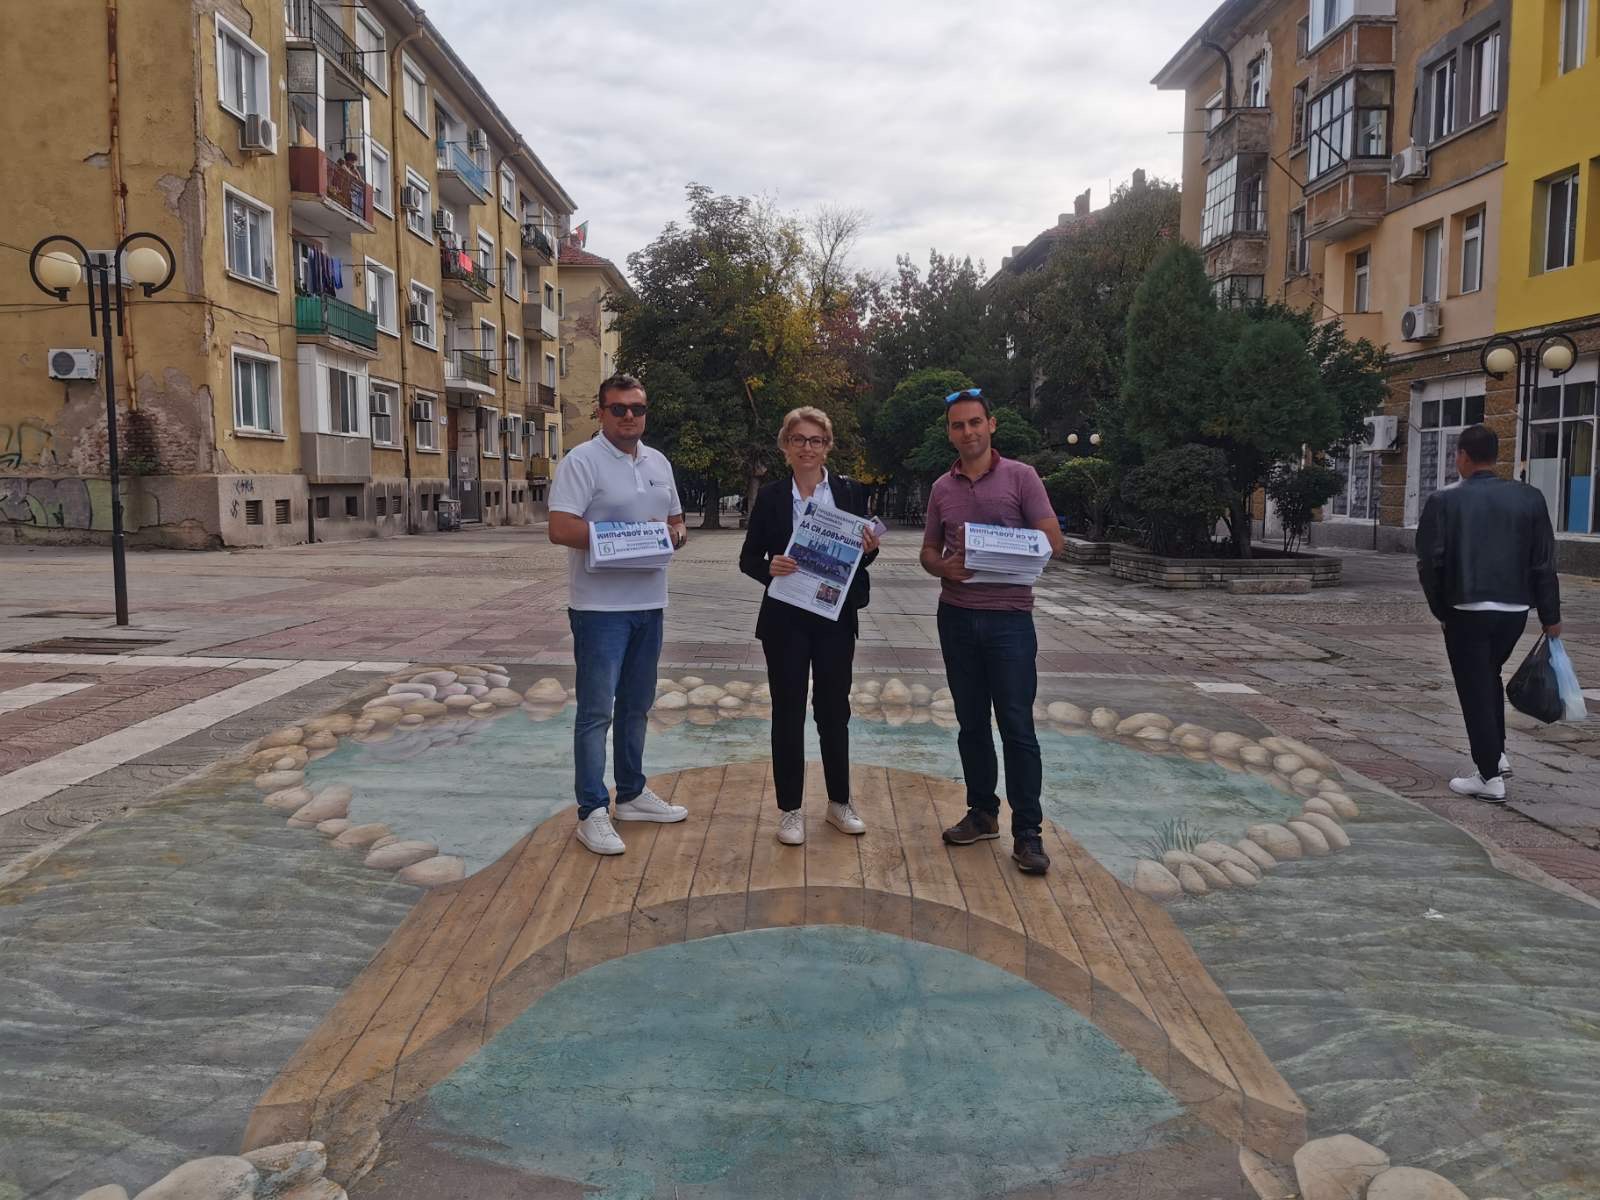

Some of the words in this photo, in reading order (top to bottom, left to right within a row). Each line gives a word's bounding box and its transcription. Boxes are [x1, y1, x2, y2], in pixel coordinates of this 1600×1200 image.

[597, 529, 641, 540] ДОВЪРШИМ
[643, 528, 654, 536] СИ
[654, 528, 665, 536] ДА
[799, 520, 810, 530] ДА
[811, 524, 821, 534] СИ
[821, 528, 862, 549] ДОВЪРШИМ
